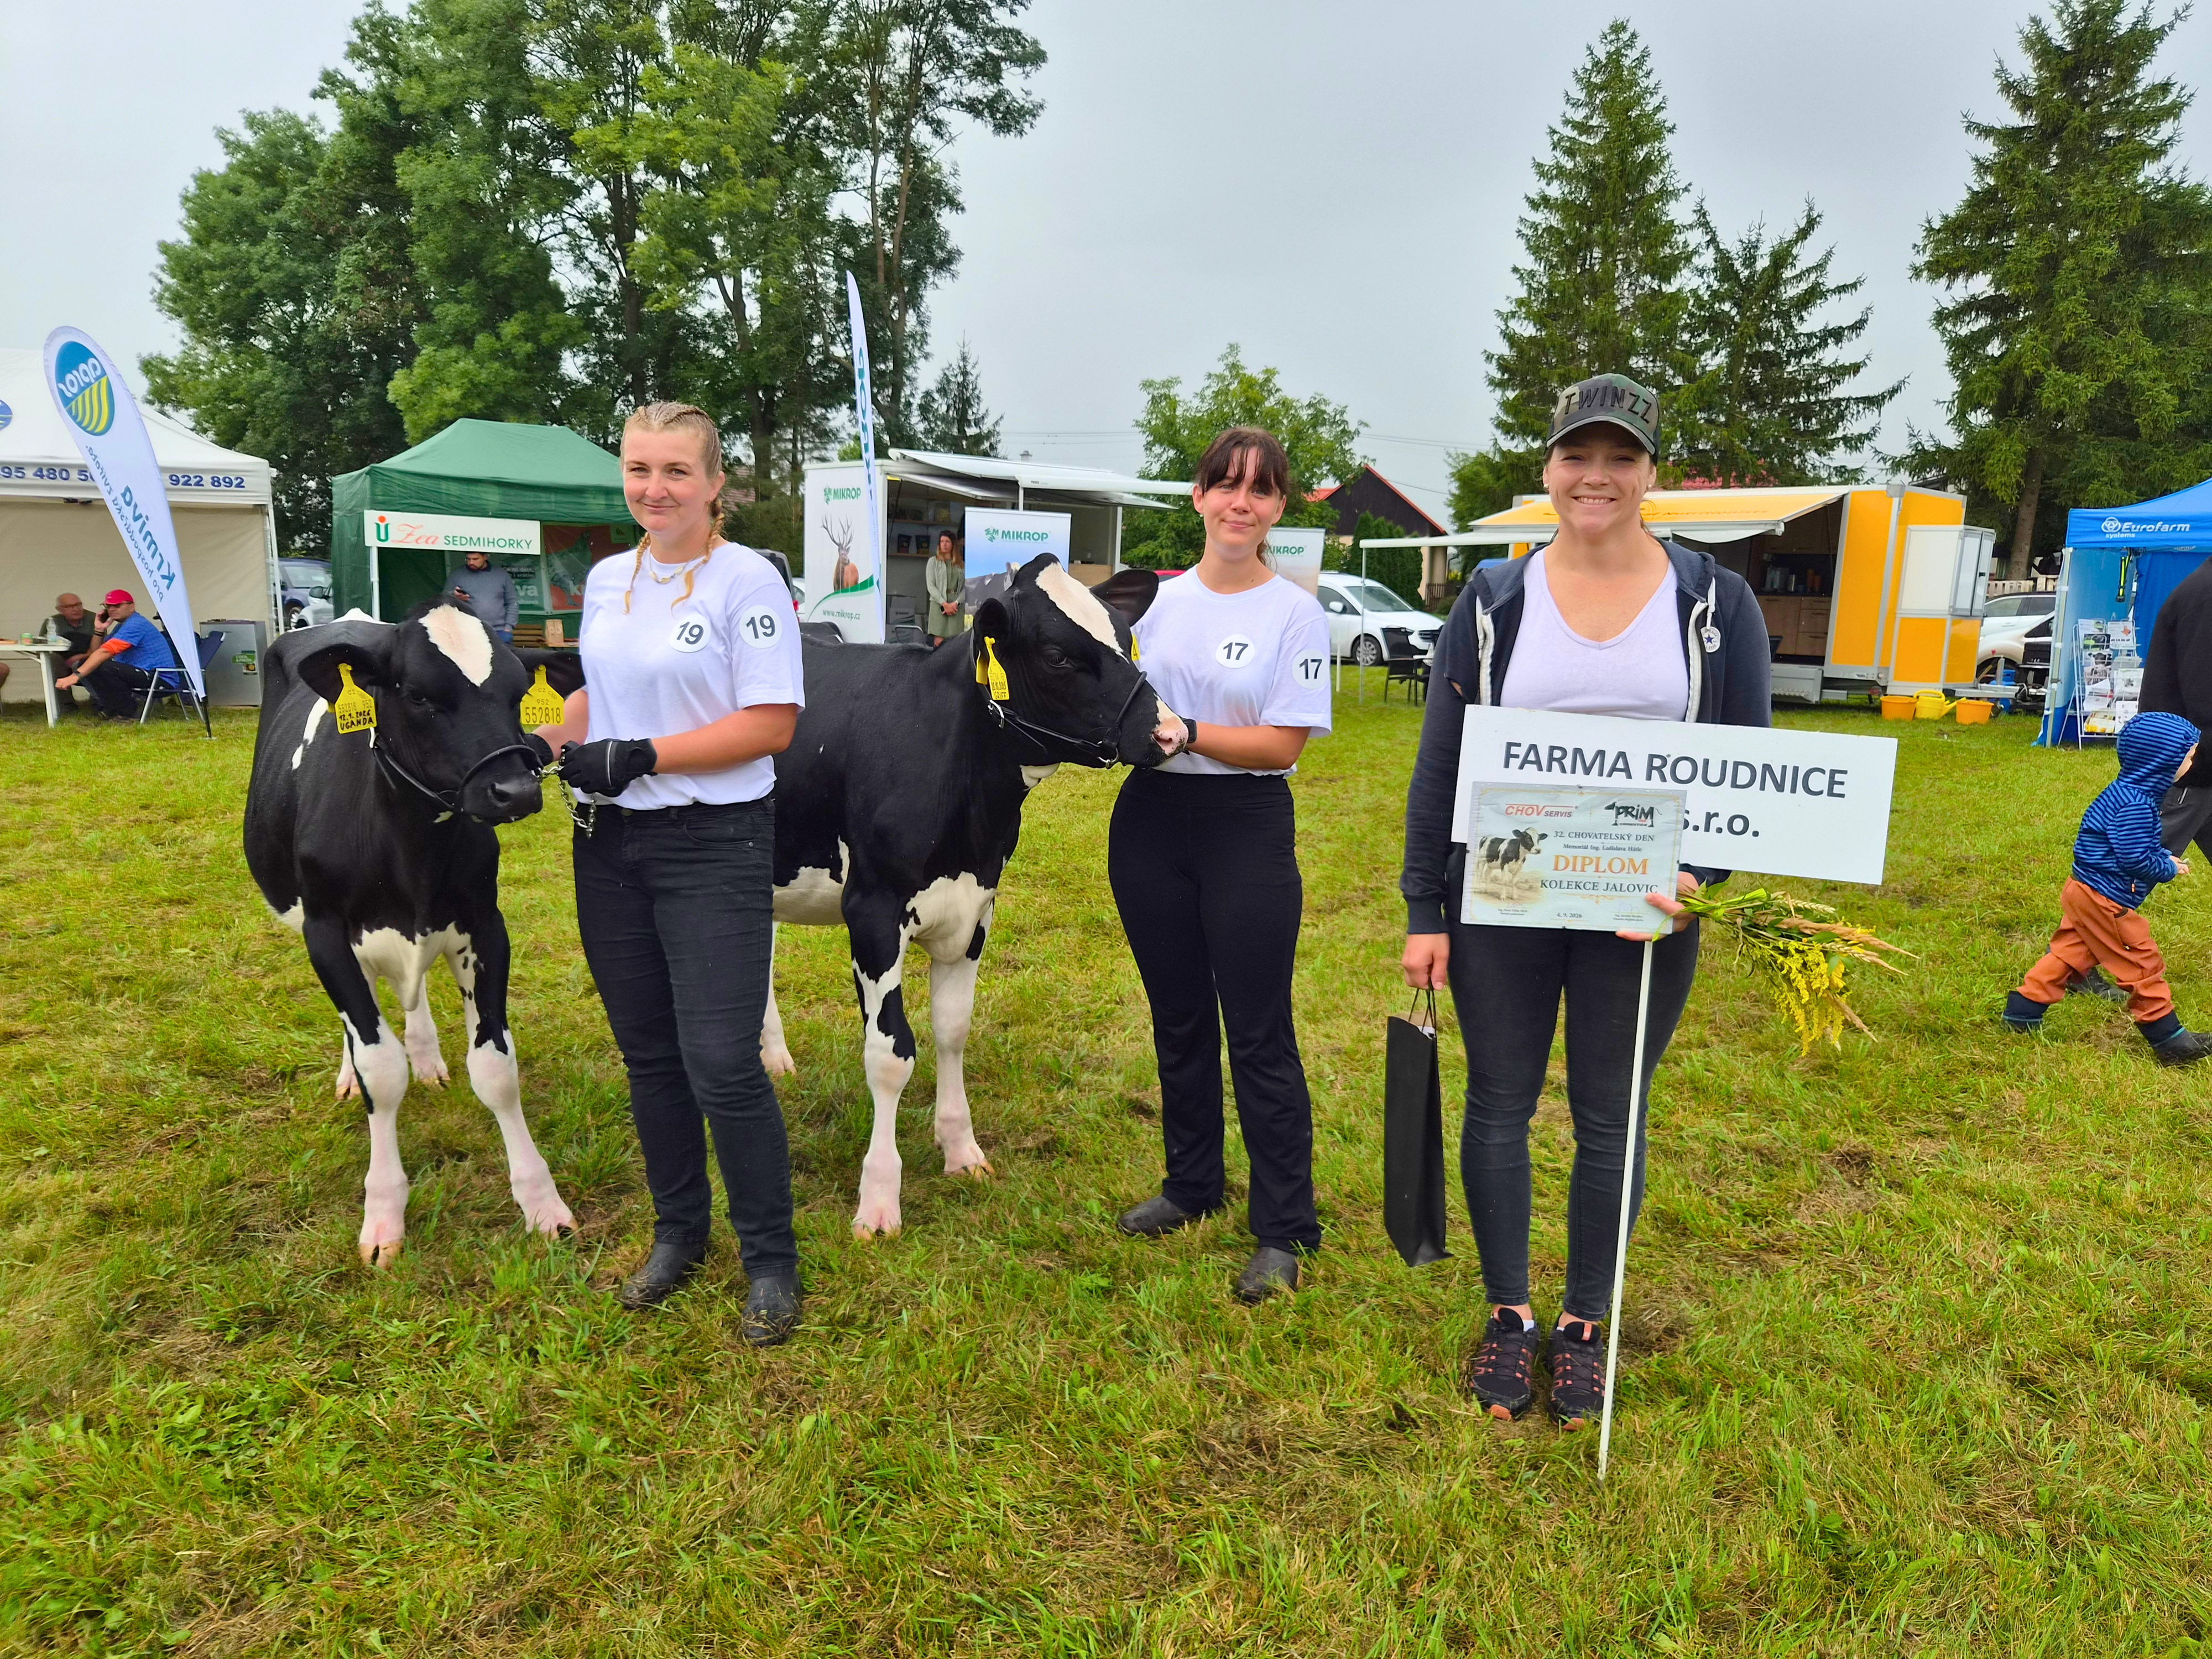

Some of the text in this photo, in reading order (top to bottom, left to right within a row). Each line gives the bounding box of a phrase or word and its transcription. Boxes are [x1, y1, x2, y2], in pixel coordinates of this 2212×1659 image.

[1564, 385, 1652, 424] TWINZZ
[33, 467, 70, 481] 480
[168, 474, 205, 487] 922
[210, 476, 246, 488] 892
[833, 487, 862, 500] MIKROP
[2121, 521, 2190, 532] Eurofarm
[444, 535, 532, 549] SEDMIHORKY
[1001, 530, 1049, 541] MIKROP
[822, 609, 861, 620] www.mikrop.cz
[676, 621, 704, 645] 19
[746, 614, 776, 639] 19
[1223, 642, 1249, 660] 17
[1299, 658, 1323, 680] 17
[340, 717, 374, 731] UGANDA
[525, 707, 561, 724] 552818
[1503, 742, 1848, 799] FARMA ROUDNICE
[1568, 831, 1632, 841] CHOVATELSKÝ
[1552, 854, 1649, 875] DIPLOM
[1540, 879, 1658, 893] KOLEKCE JALOVIC
